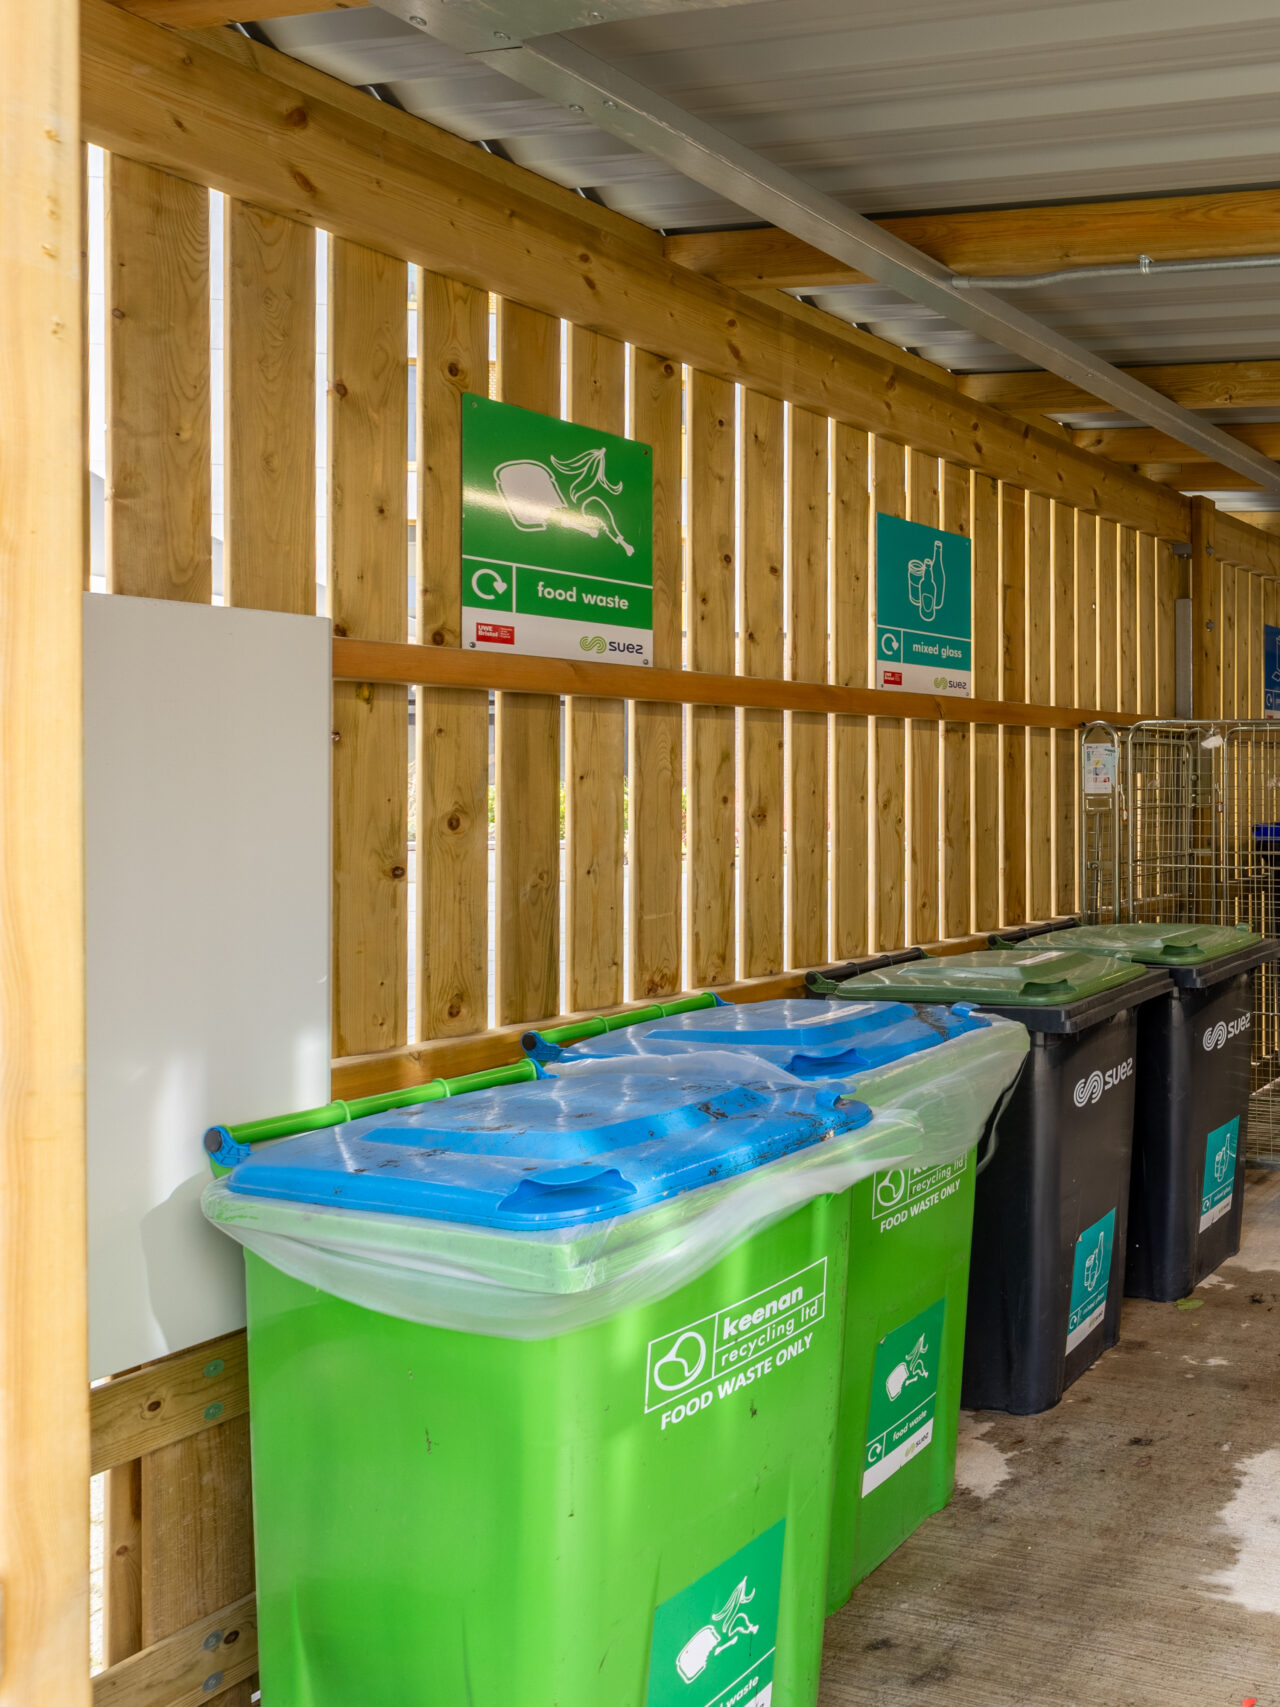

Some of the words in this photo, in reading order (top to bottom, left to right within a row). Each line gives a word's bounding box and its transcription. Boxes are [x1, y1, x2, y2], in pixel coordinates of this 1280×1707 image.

[537, 581, 577, 602] food
[582, 592, 629, 610] waste
[608, 641, 643, 655] suez
[912, 641, 939, 655] mixed
[941, 645, 962, 659] glass
[948, 680, 967, 690] suez
[1228, 1012, 1250, 1039] suez
[1104, 1058, 1133, 1091] suez
[912, 1166, 952, 1195] recycling
[880, 1210, 908, 1233] FOOD
[910, 1192, 940, 1217] WASTE
[941, 1179, 961, 1200] ONLY
[723, 1286, 804, 1340] keenan
[721, 1318, 795, 1367] recycling
[801, 1299, 818, 1323] ltd
[661, 1391, 713, 1431] FOOD
[717, 1356, 773, 1399] WASTE
[775, 1332, 813, 1367] ONLY
[892, 1422, 909, 1442] food
[909, 1410, 927, 1428] waste
[726, 1676, 759, 1707] waste
